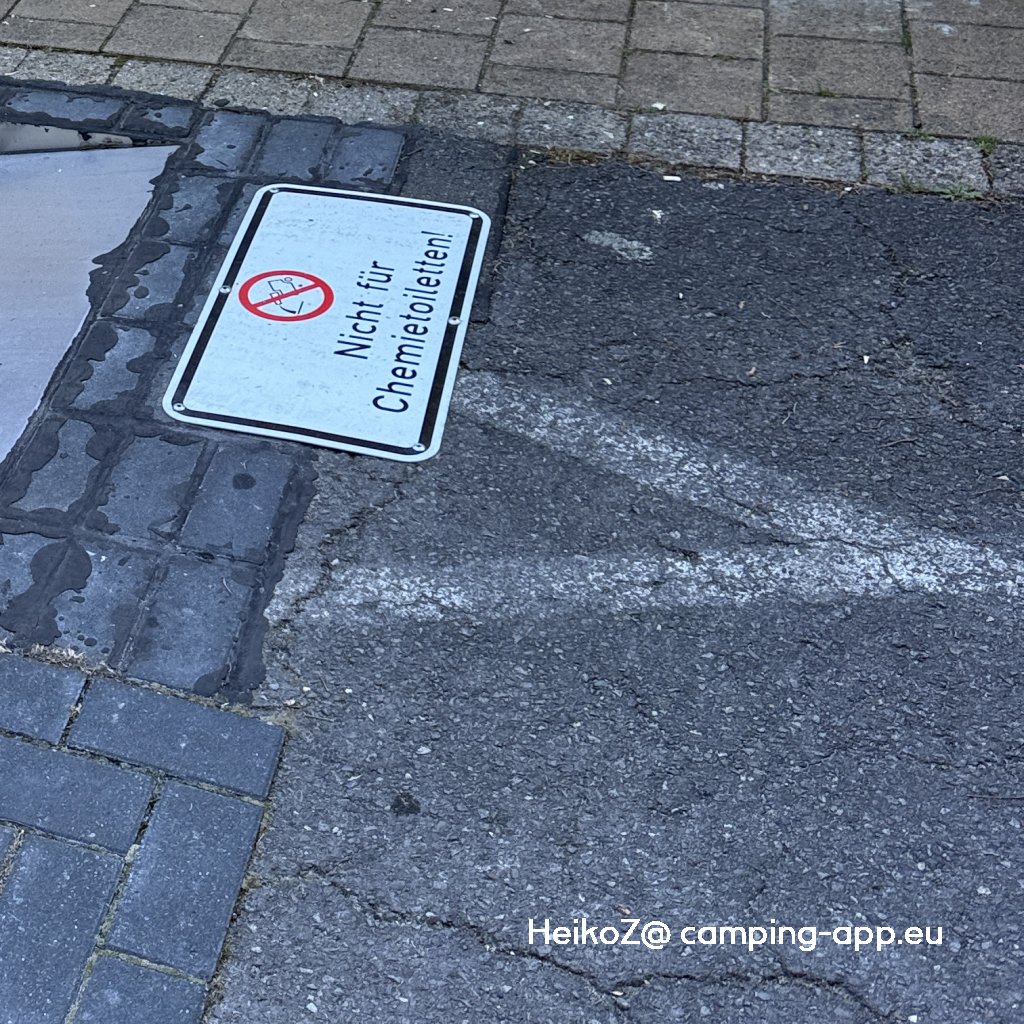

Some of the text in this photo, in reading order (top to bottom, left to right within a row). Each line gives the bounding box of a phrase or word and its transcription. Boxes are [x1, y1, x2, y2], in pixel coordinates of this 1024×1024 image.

[333, 260, 395, 360] Nicht für
[372, 230, 454, 413] Chemietoiletten!
